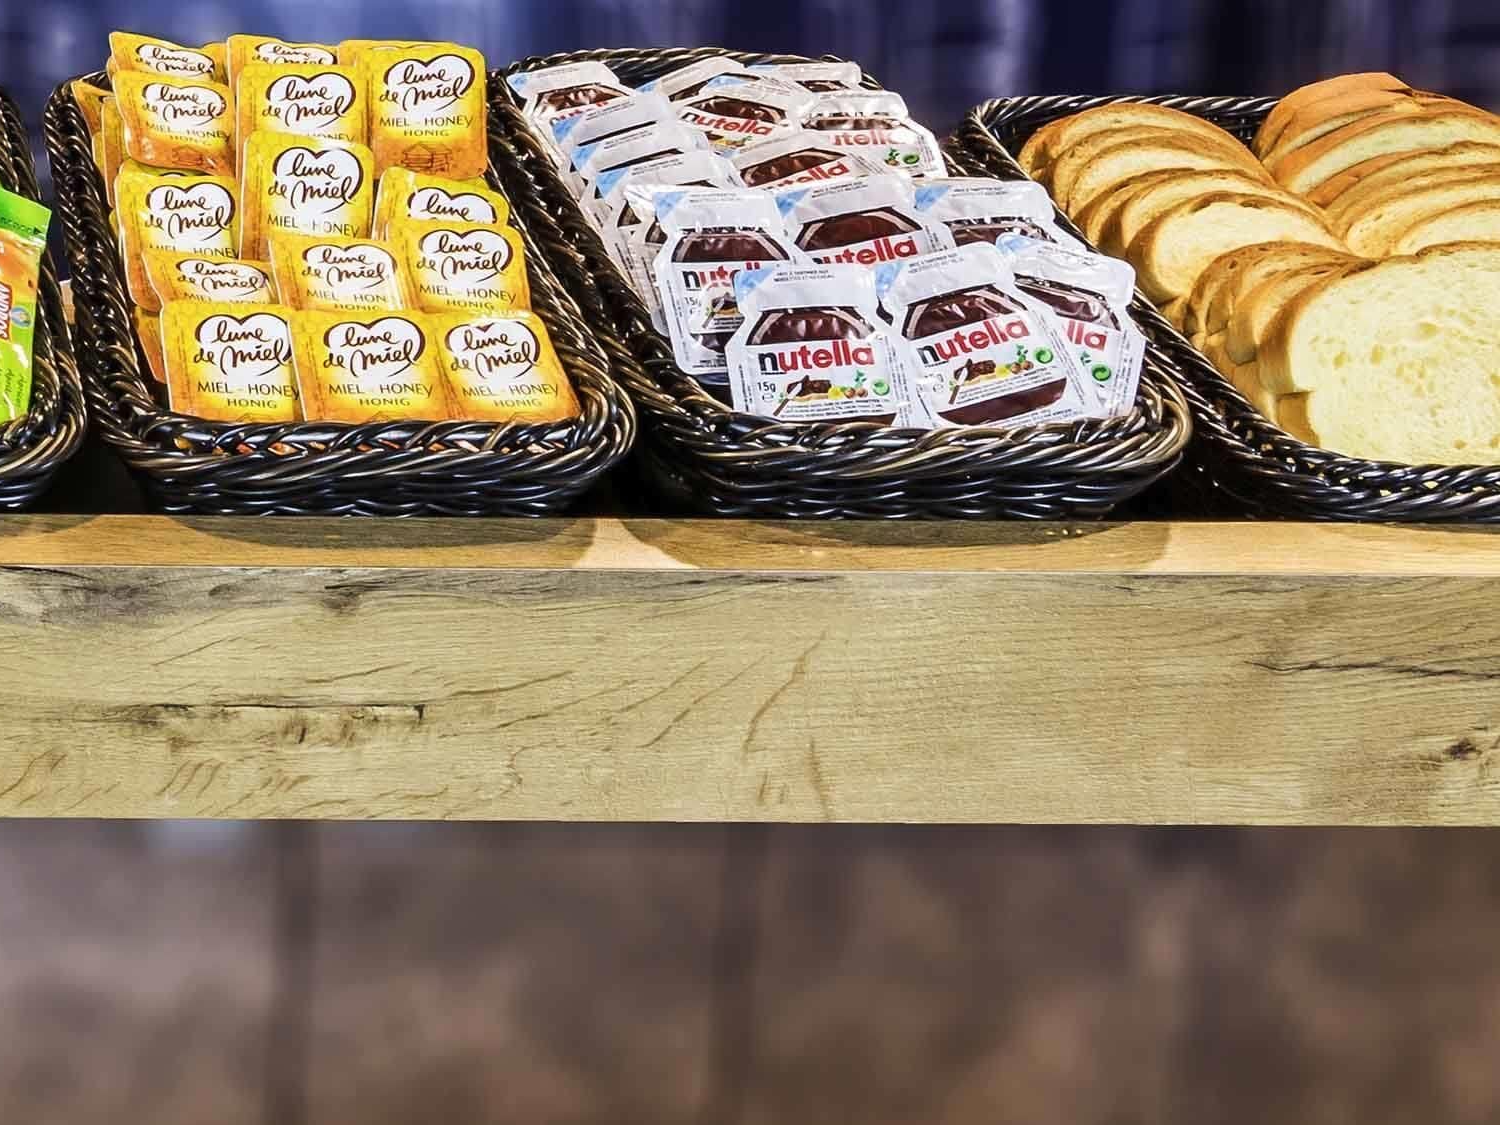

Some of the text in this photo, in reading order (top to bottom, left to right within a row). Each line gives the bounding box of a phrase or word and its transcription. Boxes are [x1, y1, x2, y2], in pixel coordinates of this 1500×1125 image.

[380, 115, 474, 129] MIEL HONEY
[682, 112, 773, 136] nutella
[403, 129, 449, 138] HONIG
[419, 284, 517, 304] MIEL HONEY
[446, 299, 495, 310] HONIG
[917, 318, 1031, 367] nutella
[758, 339, 875, 374] nutella
[197, 381, 299, 398] MIEL HONEY
[328, 382, 433, 399] MIEL HONEY
[462, 384, 560, 399] MIEL HONEY
[757, 382, 776, 393] 15g
[227, 398, 278, 409] HONIG
[359, 398, 411, 408] HONIG
[492, 399, 543, 409] HONIG
